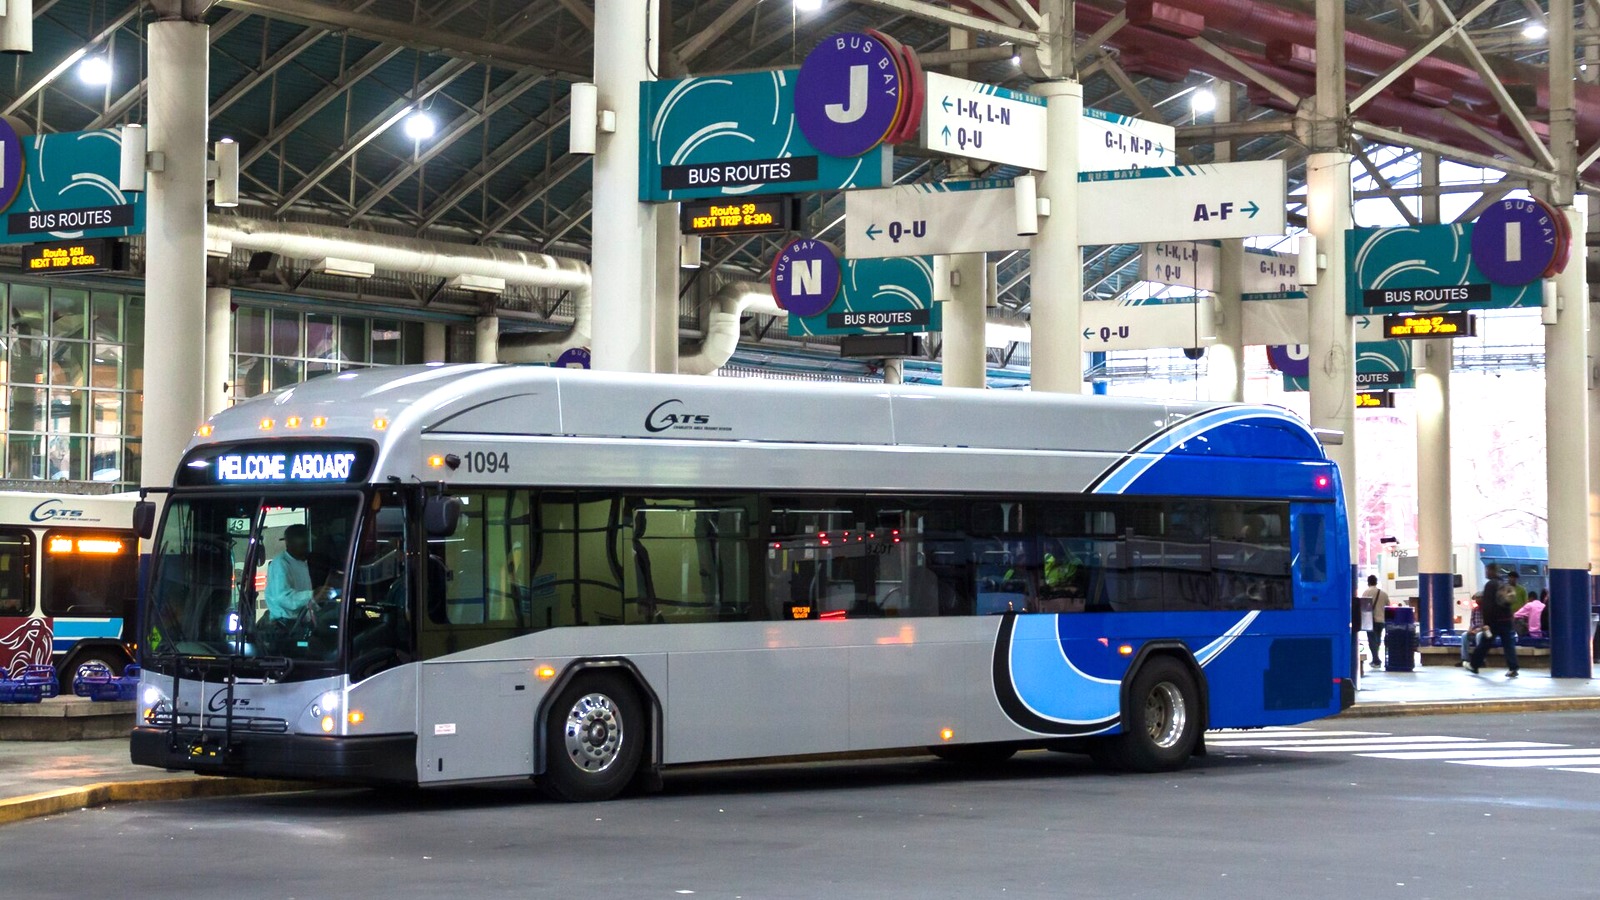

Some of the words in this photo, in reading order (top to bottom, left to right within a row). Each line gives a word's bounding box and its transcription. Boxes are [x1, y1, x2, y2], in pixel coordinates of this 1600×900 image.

[836, 37, 873, 53] BUS
[878, 57, 896, 97] BAY
[825, 64, 868, 123] J
[957, 97, 982, 123] I-K,
[987, 104, 1010, 126] L-N
[957, 127, 982, 150] Q-U
[1105, 130, 1126, 154] G-I,
[1130, 136, 1152, 155] N-P
[688, 167, 721, 184] BUS
[724, 163, 791, 182] ROUTES
[995, 179, 1015, 188] BAY
[1113, 169, 1141, 179] BAYS
[29, 214, 56, 229] BUS
[59, 209, 112, 227] ROUTES
[710, 205, 740, 216] Route
[741, 203, 756, 215] 39
[1193, 202, 1234, 222] A-F
[693, 216, 718, 228] NEXT
[719, 215, 742, 227] TRIP
[743, 213, 772, 225] 8:30A
[1505, 201, 1535, 214] BUS
[1538, 216, 1554, 245] BAY
[888, 220, 927, 243] Q-U
[1505, 221, 1521, 262] I
[30, 258, 50, 268] NEXT
[52, 256, 70, 267] TRIP
[43, 248, 67, 258] Route
[776, 254, 789, 282] BUS
[793, 241, 816, 253] BAY
[791, 259, 822, 296] N
[1165, 264, 1181, 281] Q-U
[1279, 263, 1296, 277] N-P
[1385, 290, 1411, 303] BUS
[1414, 287, 1469, 302] ROUTES
[844, 313, 866, 325] BUS
[868, 311, 912, 324] ROUTES
[1100, 326, 1129, 342] Q-U
[644, 398, 710, 433] CATS
[218, 455, 286, 480] WELCOME
[464, 451, 510, 473] 1094
[29, 498, 84, 522] CATS
